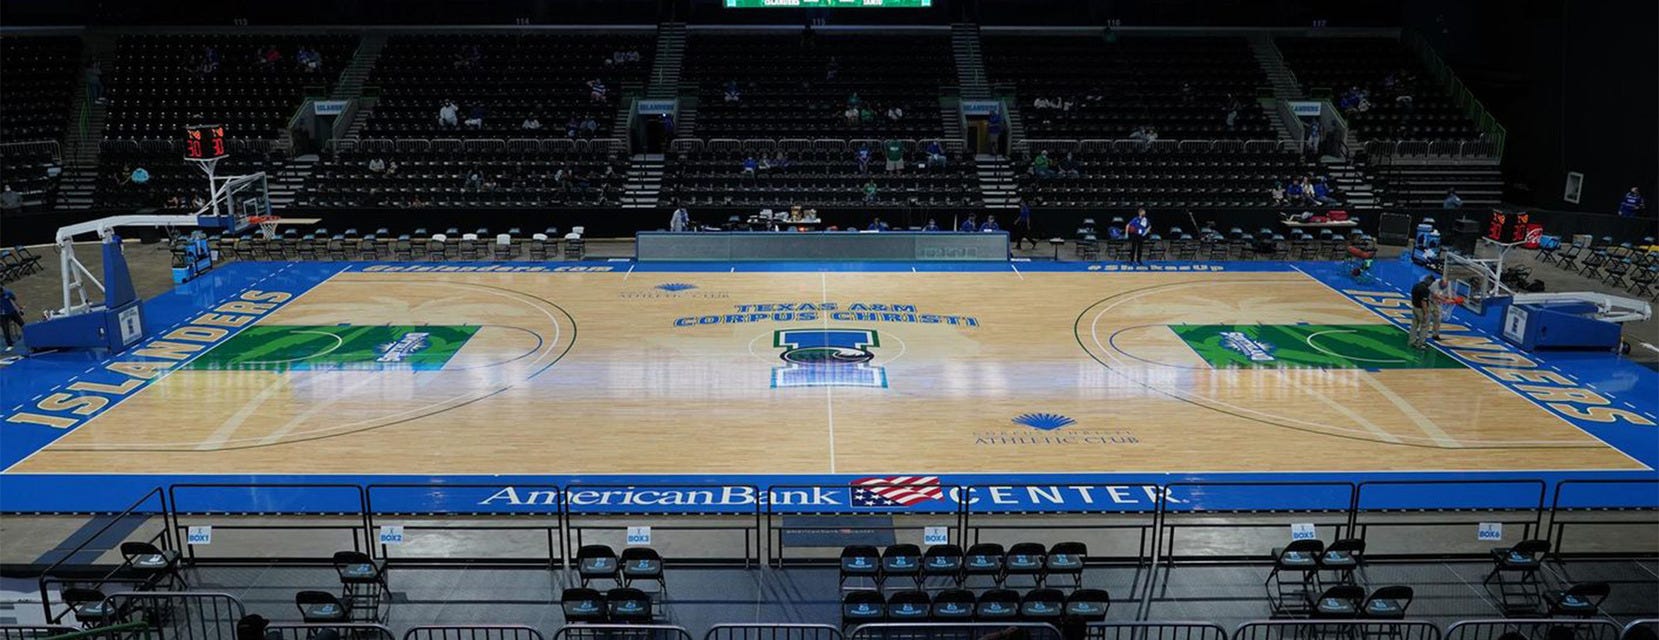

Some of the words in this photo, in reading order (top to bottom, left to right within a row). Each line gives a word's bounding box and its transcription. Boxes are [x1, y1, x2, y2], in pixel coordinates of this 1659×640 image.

[734, 303, 839, 313] TEXAS
[847, 303, 918, 313] A&M
[673, 312, 821, 327] CORPUS
[831, 312, 981, 328] CHRISTI
[6, 290, 293, 429] ISLANDERS
[975, 436, 1073, 445] ATHLETIC
[1084, 436, 1141, 445] CLUB
[949, 485, 1184, 504] CENTER
[189, 534, 209, 542] BOX1
[381, 534, 402, 542] BOX2
[628, 535, 650, 543] BOX3
[925, 534, 947, 543] BOX4
